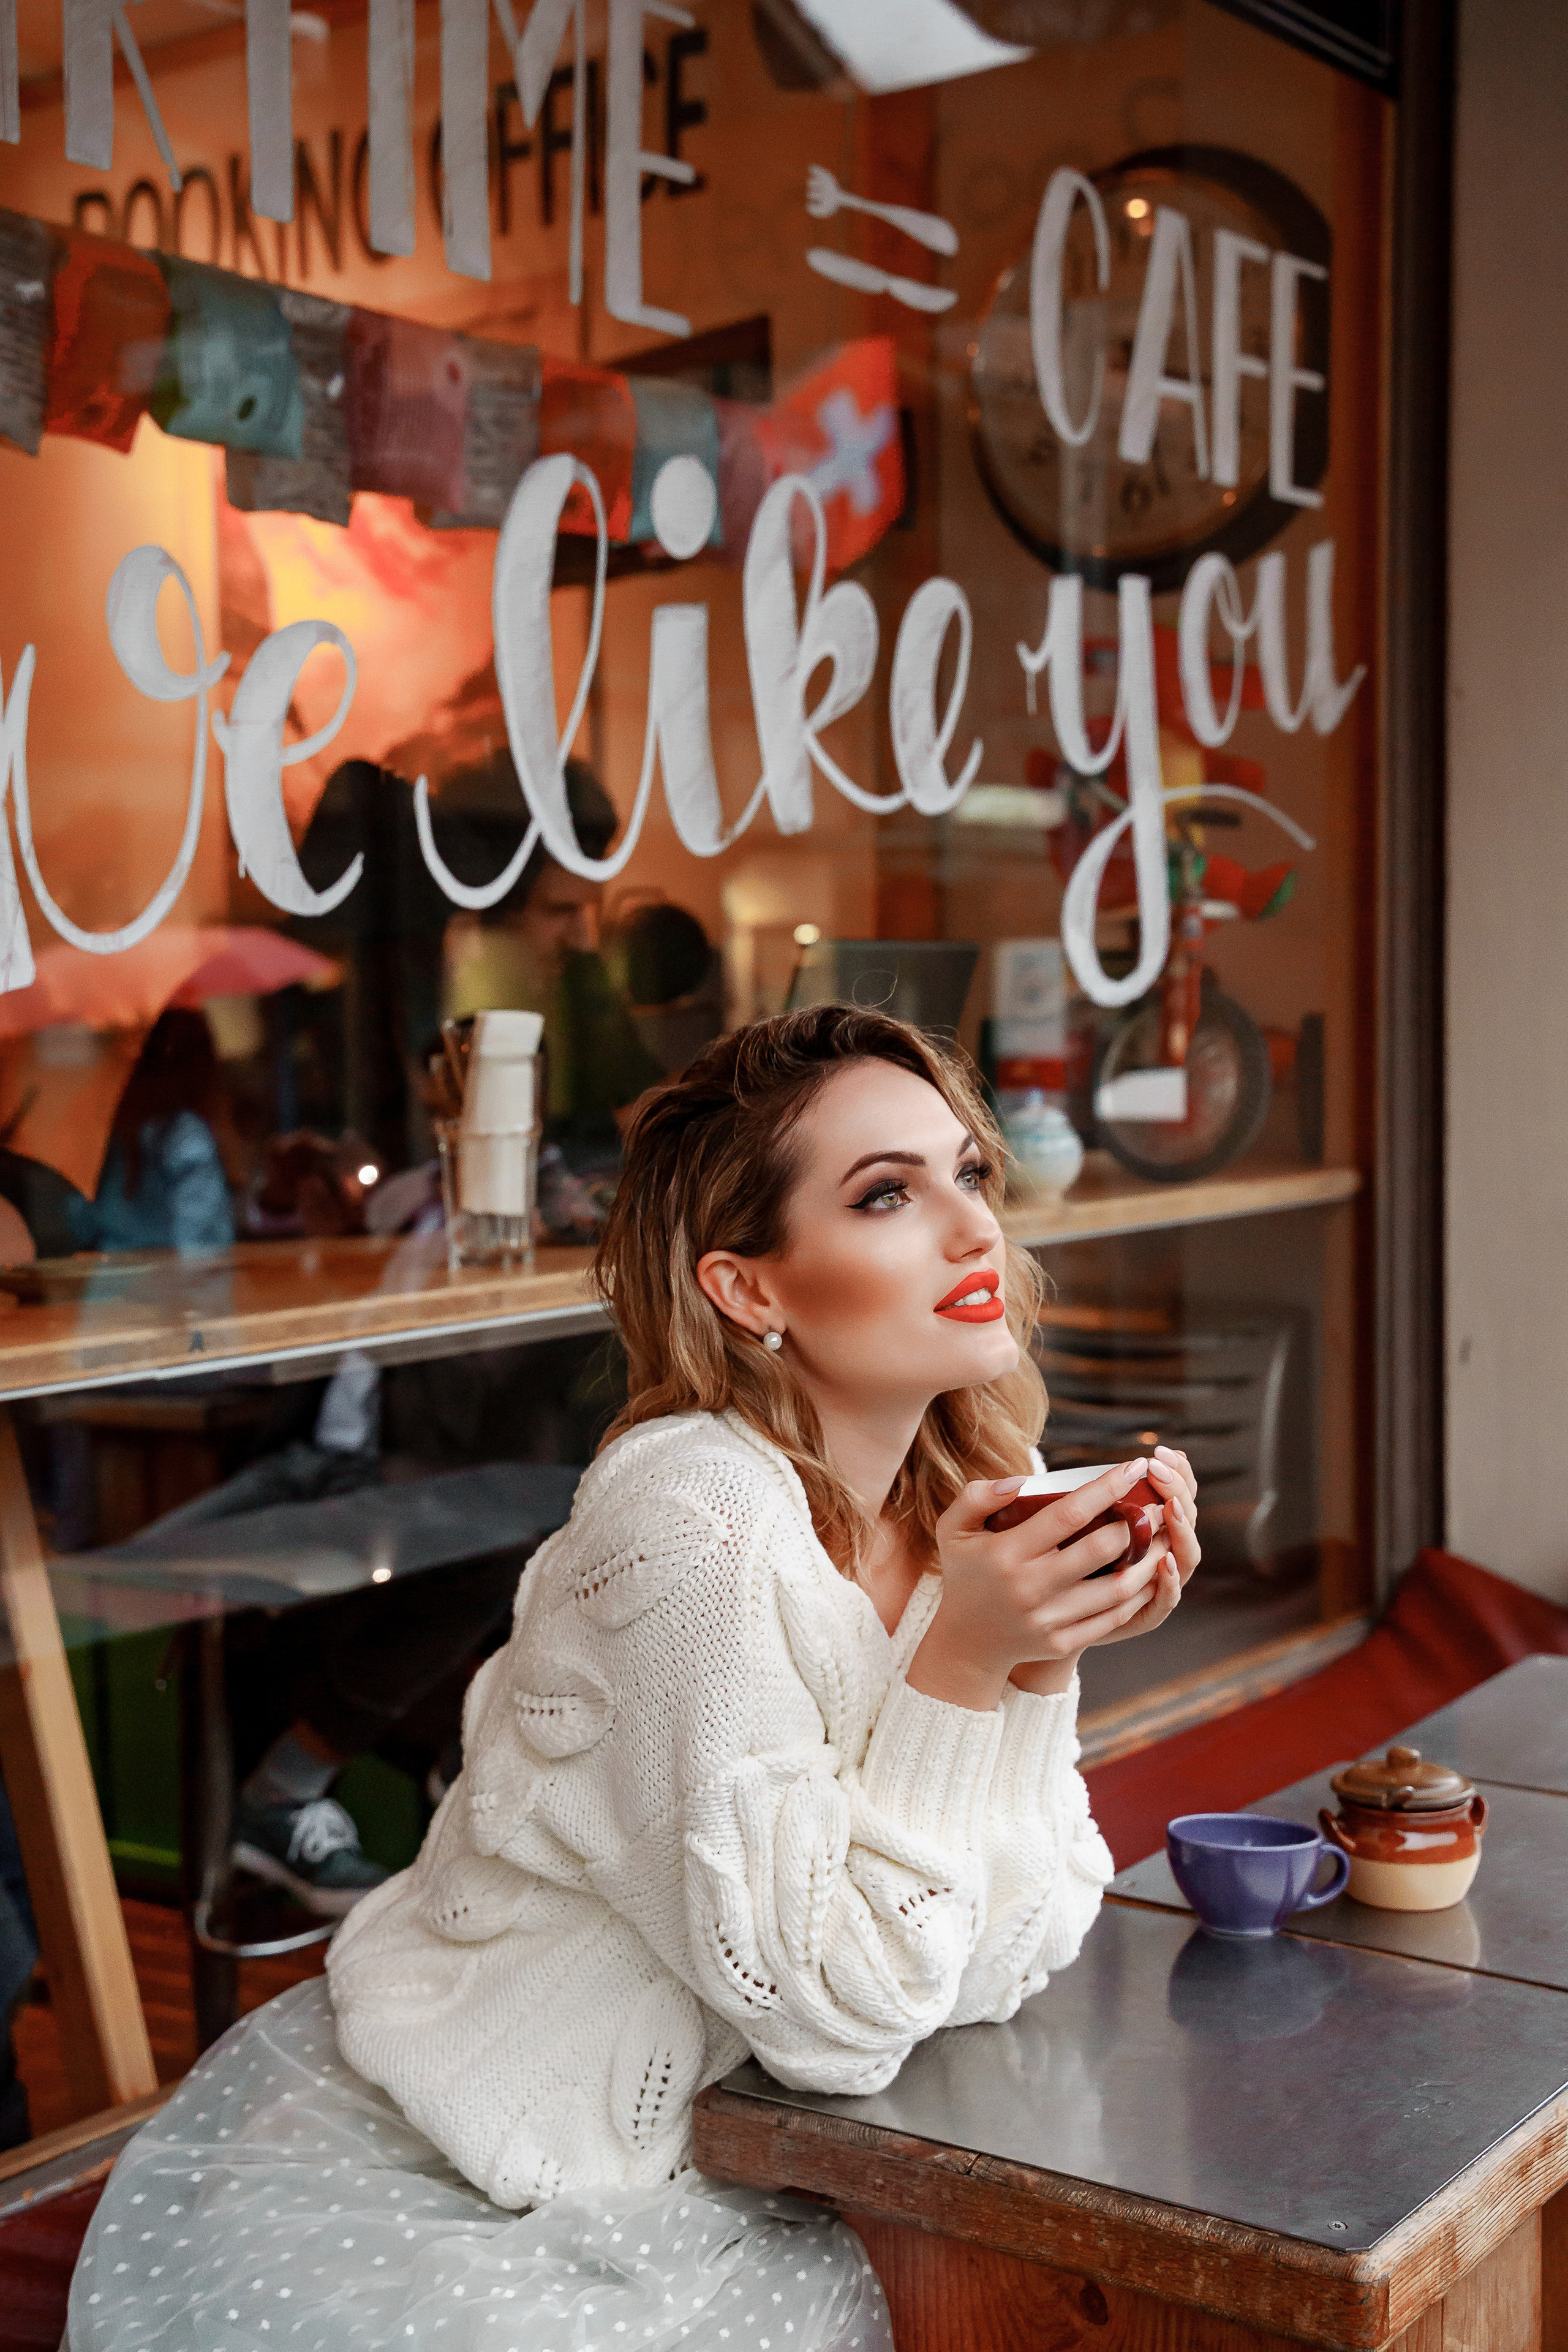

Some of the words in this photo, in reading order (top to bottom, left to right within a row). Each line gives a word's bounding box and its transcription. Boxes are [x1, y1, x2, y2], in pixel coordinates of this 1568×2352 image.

[429, 29, 710, 239] FFIE
[1030, 165, 1329, 510] CAFE
[413, 452, 984, 910] like
[1016, 540, 1368, 1008] you
